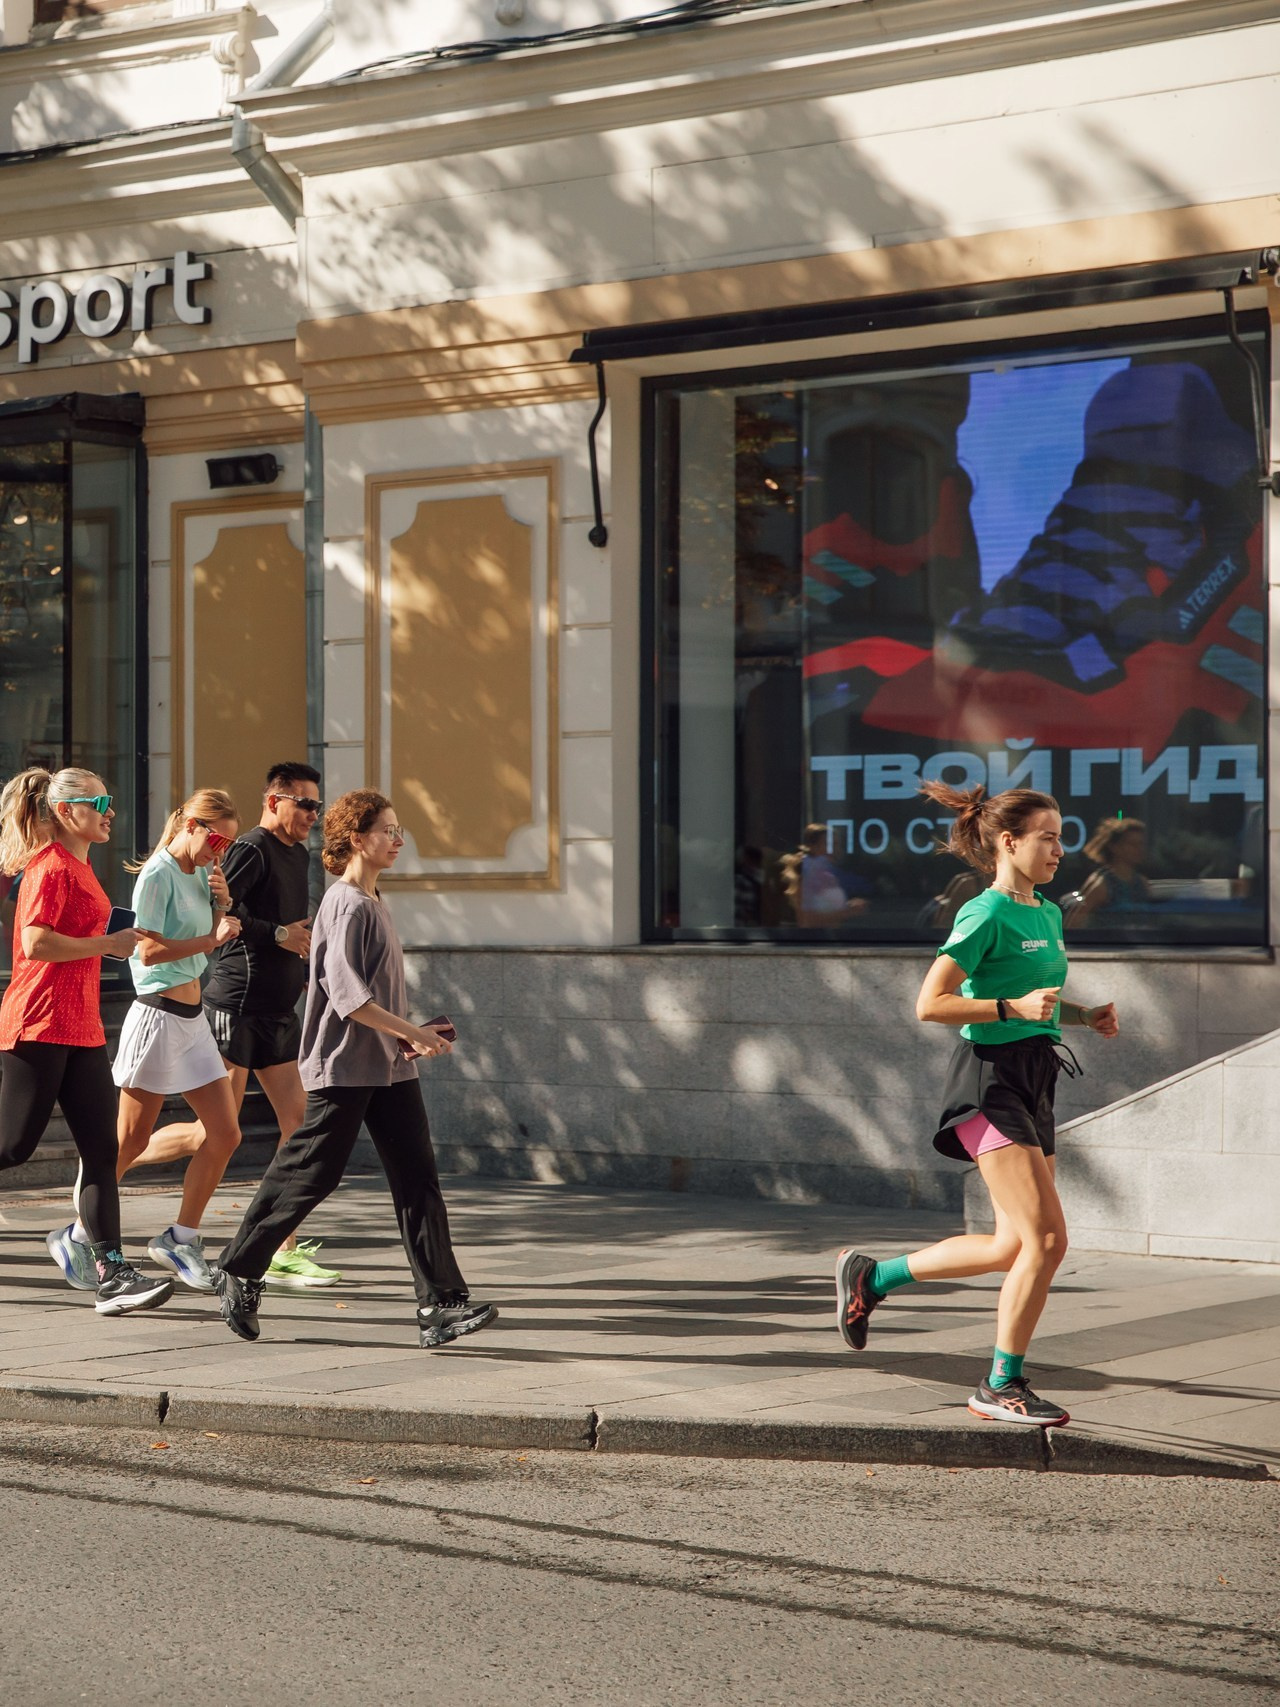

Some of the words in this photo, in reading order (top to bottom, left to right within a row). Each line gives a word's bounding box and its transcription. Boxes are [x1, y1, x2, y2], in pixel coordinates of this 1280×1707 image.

[1186, 554, 1237, 612] TERREX
[810, 737, 1052, 801] ТВОЙ
[1070, 744, 1265, 803] ГИД
[825, 818, 890, 855] ПО
